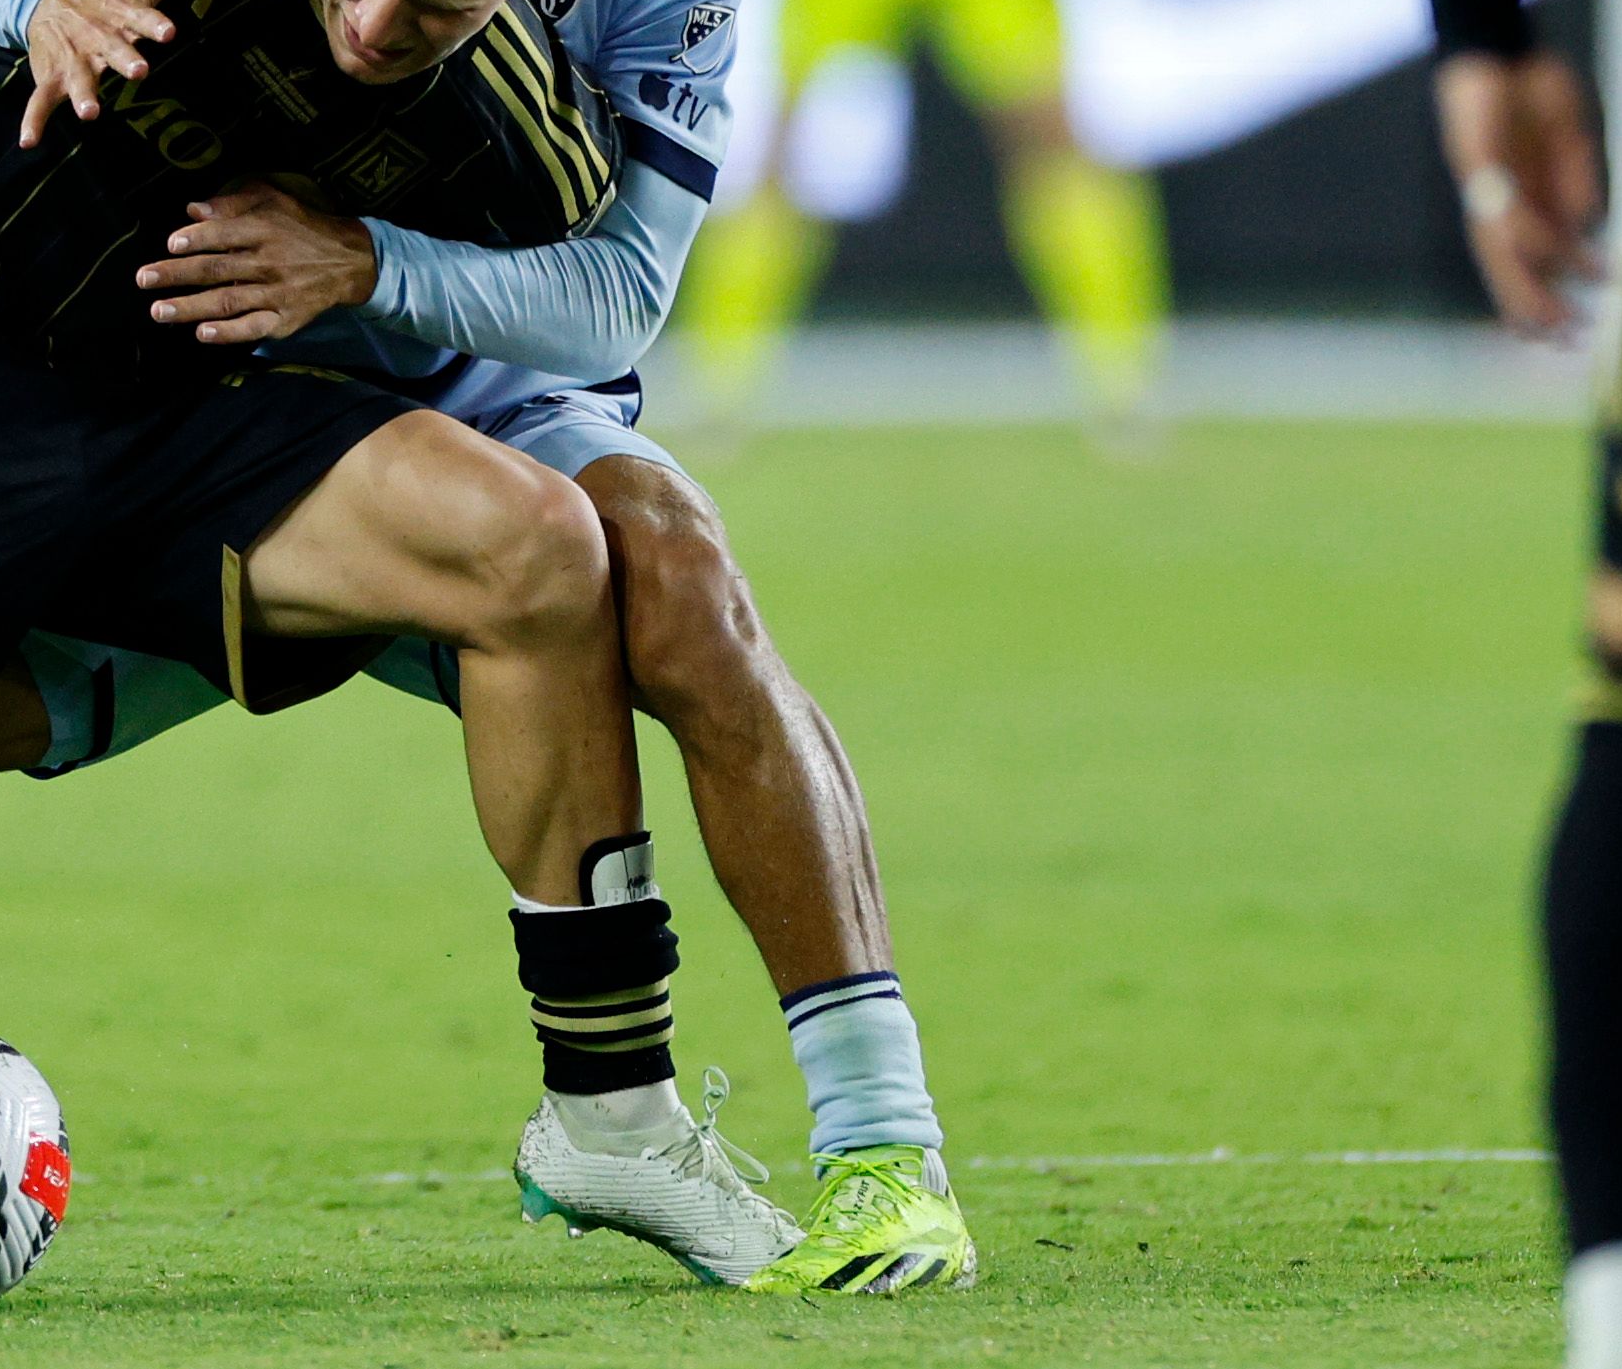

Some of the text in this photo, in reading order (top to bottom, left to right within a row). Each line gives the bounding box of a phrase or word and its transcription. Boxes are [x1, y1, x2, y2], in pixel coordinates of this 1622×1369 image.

[692, 9, 724, 28] MLS
[97, 72, 224, 170] MO
[672, 83, 709, 131] tv
